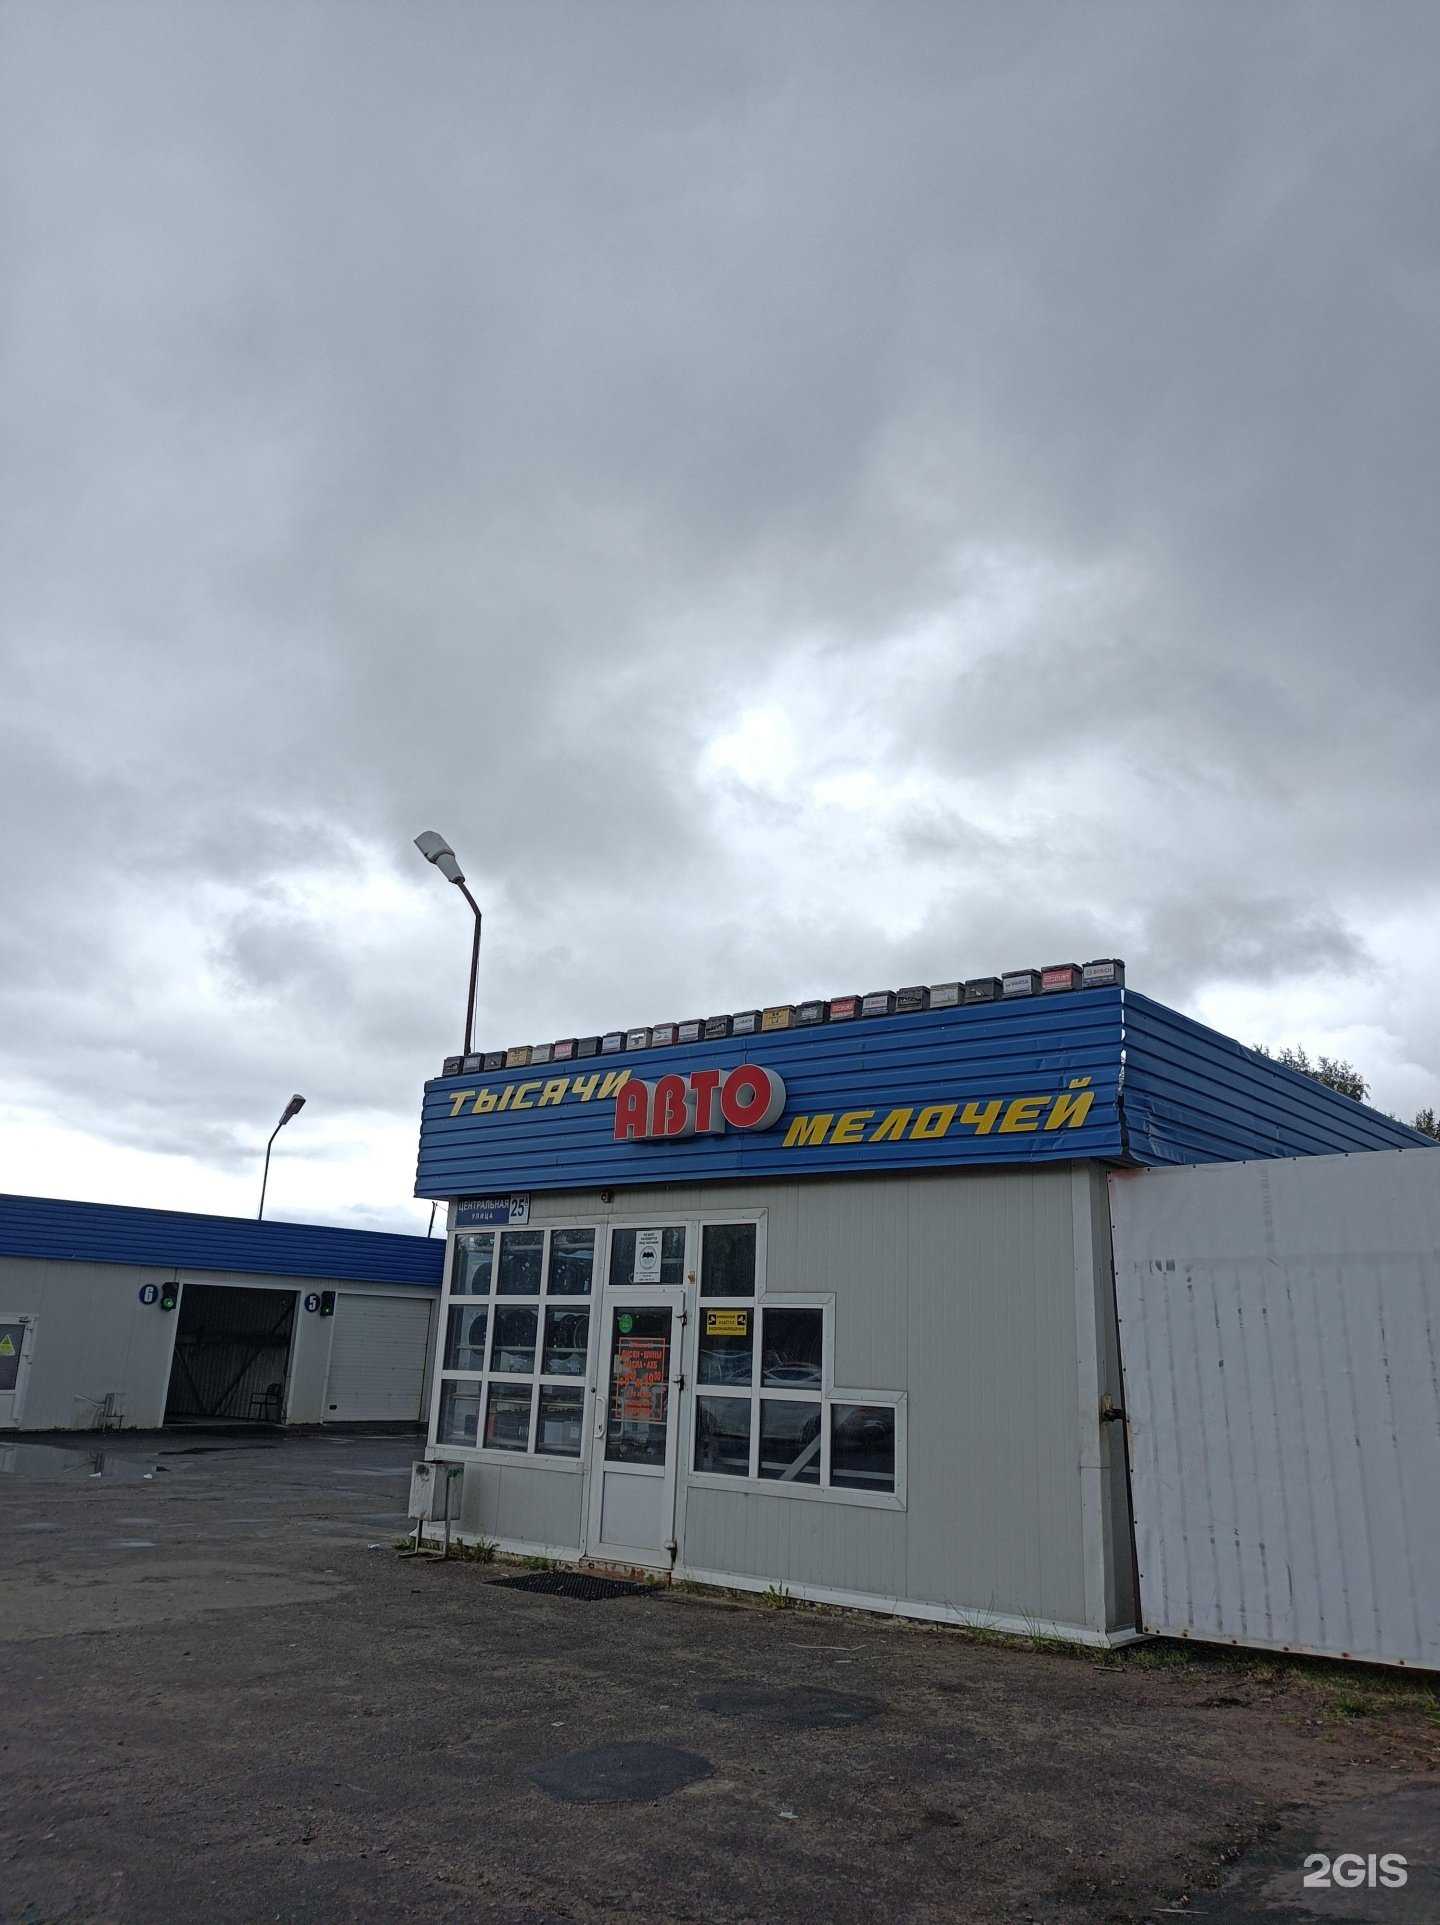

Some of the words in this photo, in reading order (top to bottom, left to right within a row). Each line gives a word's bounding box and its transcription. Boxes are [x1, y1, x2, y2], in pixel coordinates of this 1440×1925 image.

[449, 1069, 633, 1117] ТЫСЯЧИ
[613, 1063, 787, 1141] АВТО
[782, 1076, 1095, 1147] МЕЛОЧЕЙ
[459, 1199, 509, 1212] ЦЕНТРАЛЬНАЯ
[144, 1286, 153, 1303] 6
[308, 1296, 317, 1310] 5
